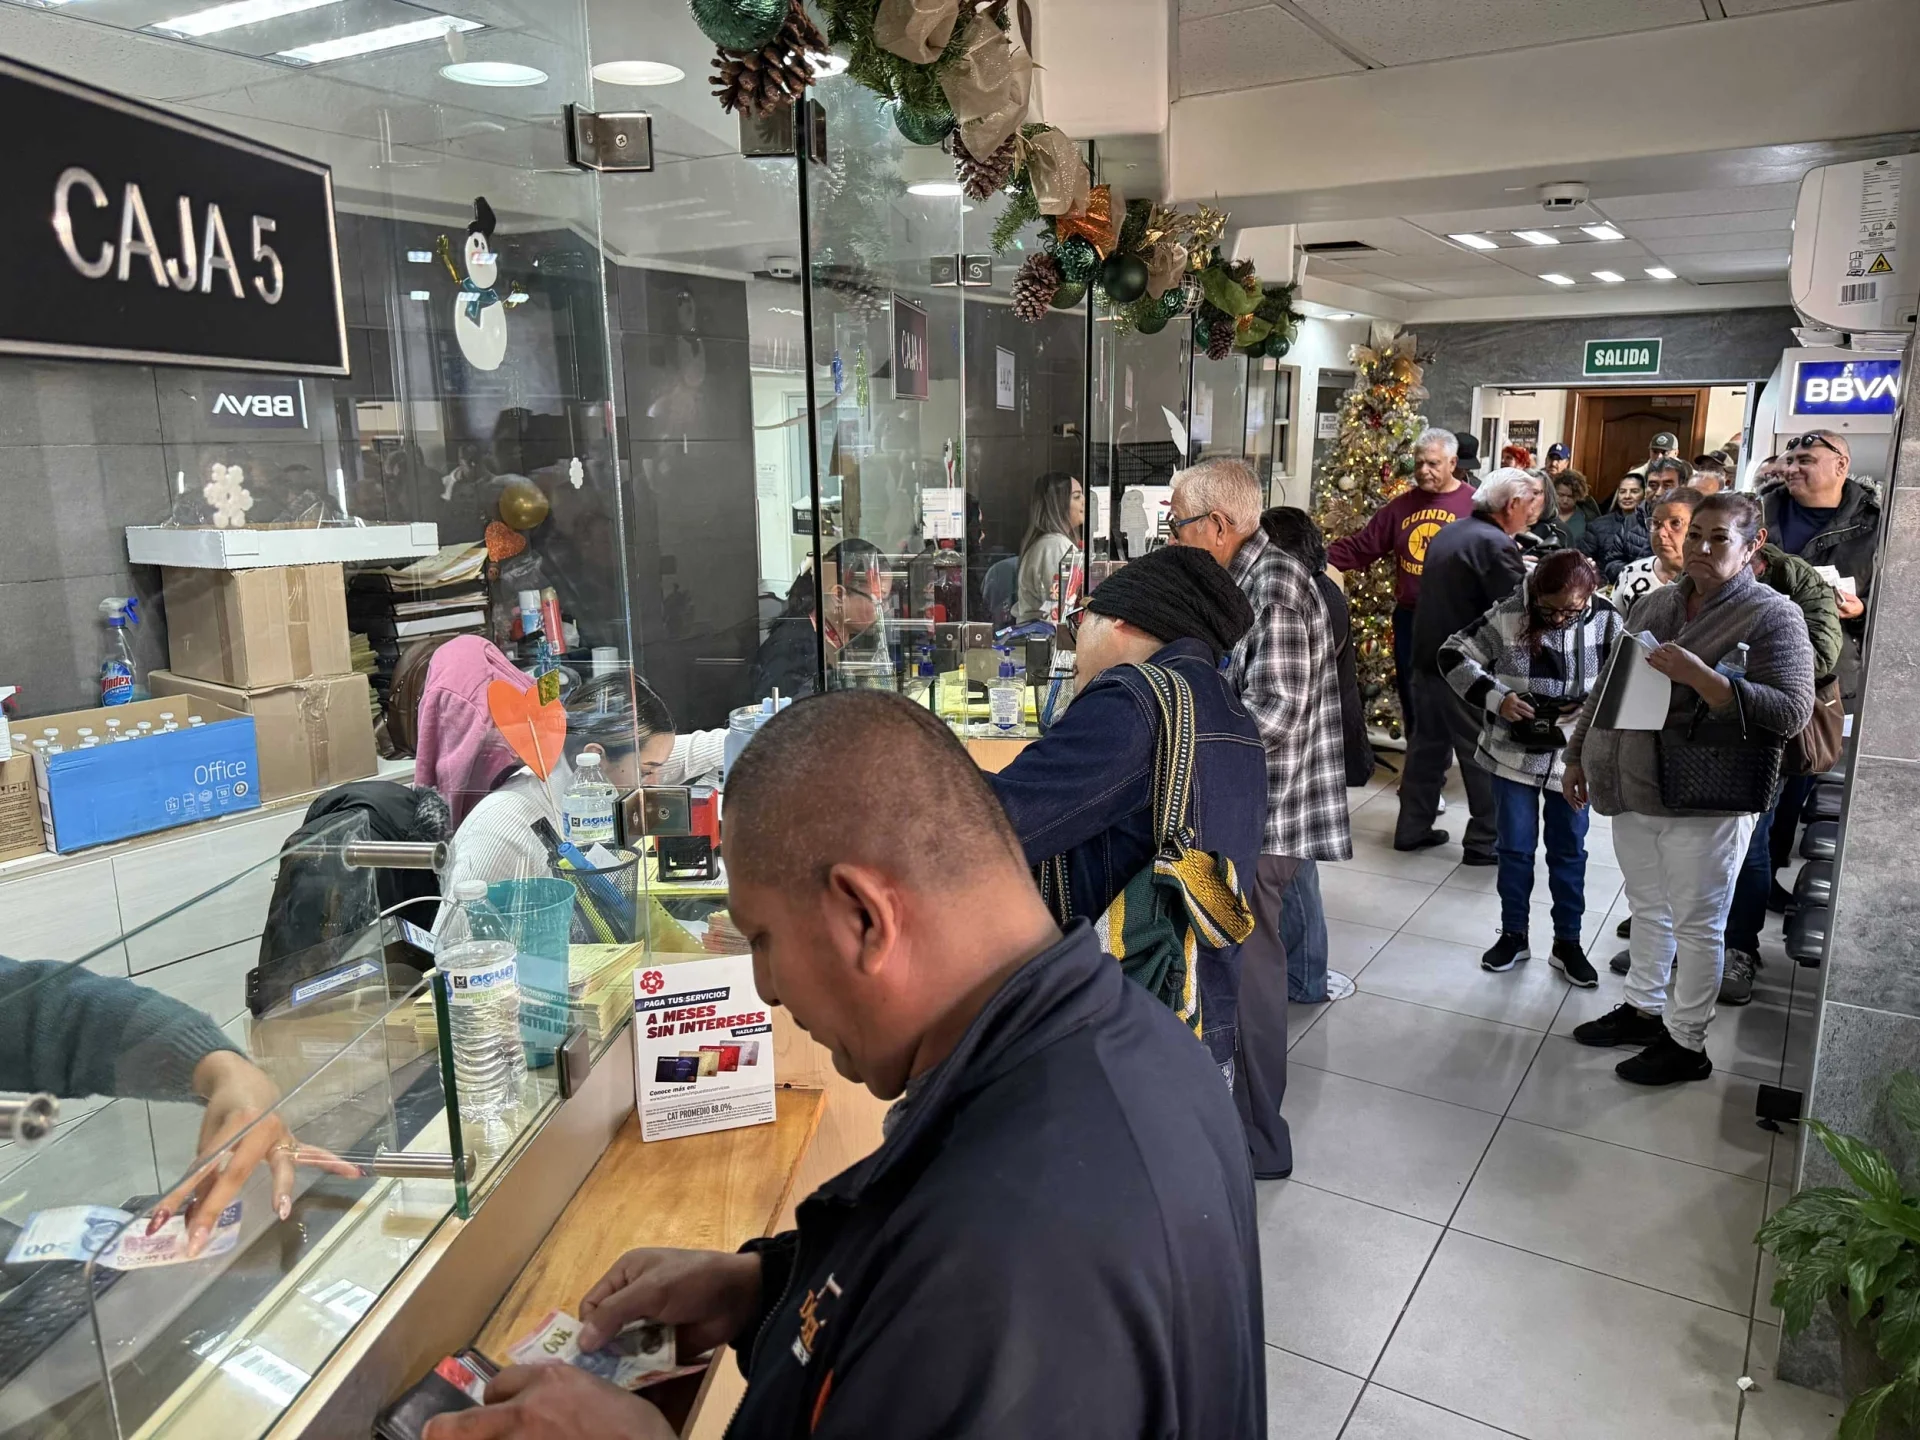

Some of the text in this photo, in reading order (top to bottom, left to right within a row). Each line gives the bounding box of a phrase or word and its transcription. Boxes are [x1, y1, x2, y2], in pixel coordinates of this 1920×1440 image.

[52, 167, 284, 305] CAJA 5
[1594, 348, 1650, 366] SALIDA
[1805, 374, 1898, 402] BBVA
[1401, 508, 1456, 530] GUINDA
[194, 760, 247, 786] Office
[470, 965, 513, 988] agua
[643, 990, 727, 1009] PAGA TUS SERVICIOS
[645, 1005, 716, 1026] A MESES
[646, 1011, 766, 1039] SIN INTERESES
[735, 1028, 754, 1036] HAZLO
[649, 1084, 697, 1097] Conoce más en:
[667, 1111, 679, 1121] CAT
[679, 1105, 711, 1119] PROMEDIO
[711, 1102, 733, 1114] 88.0%
